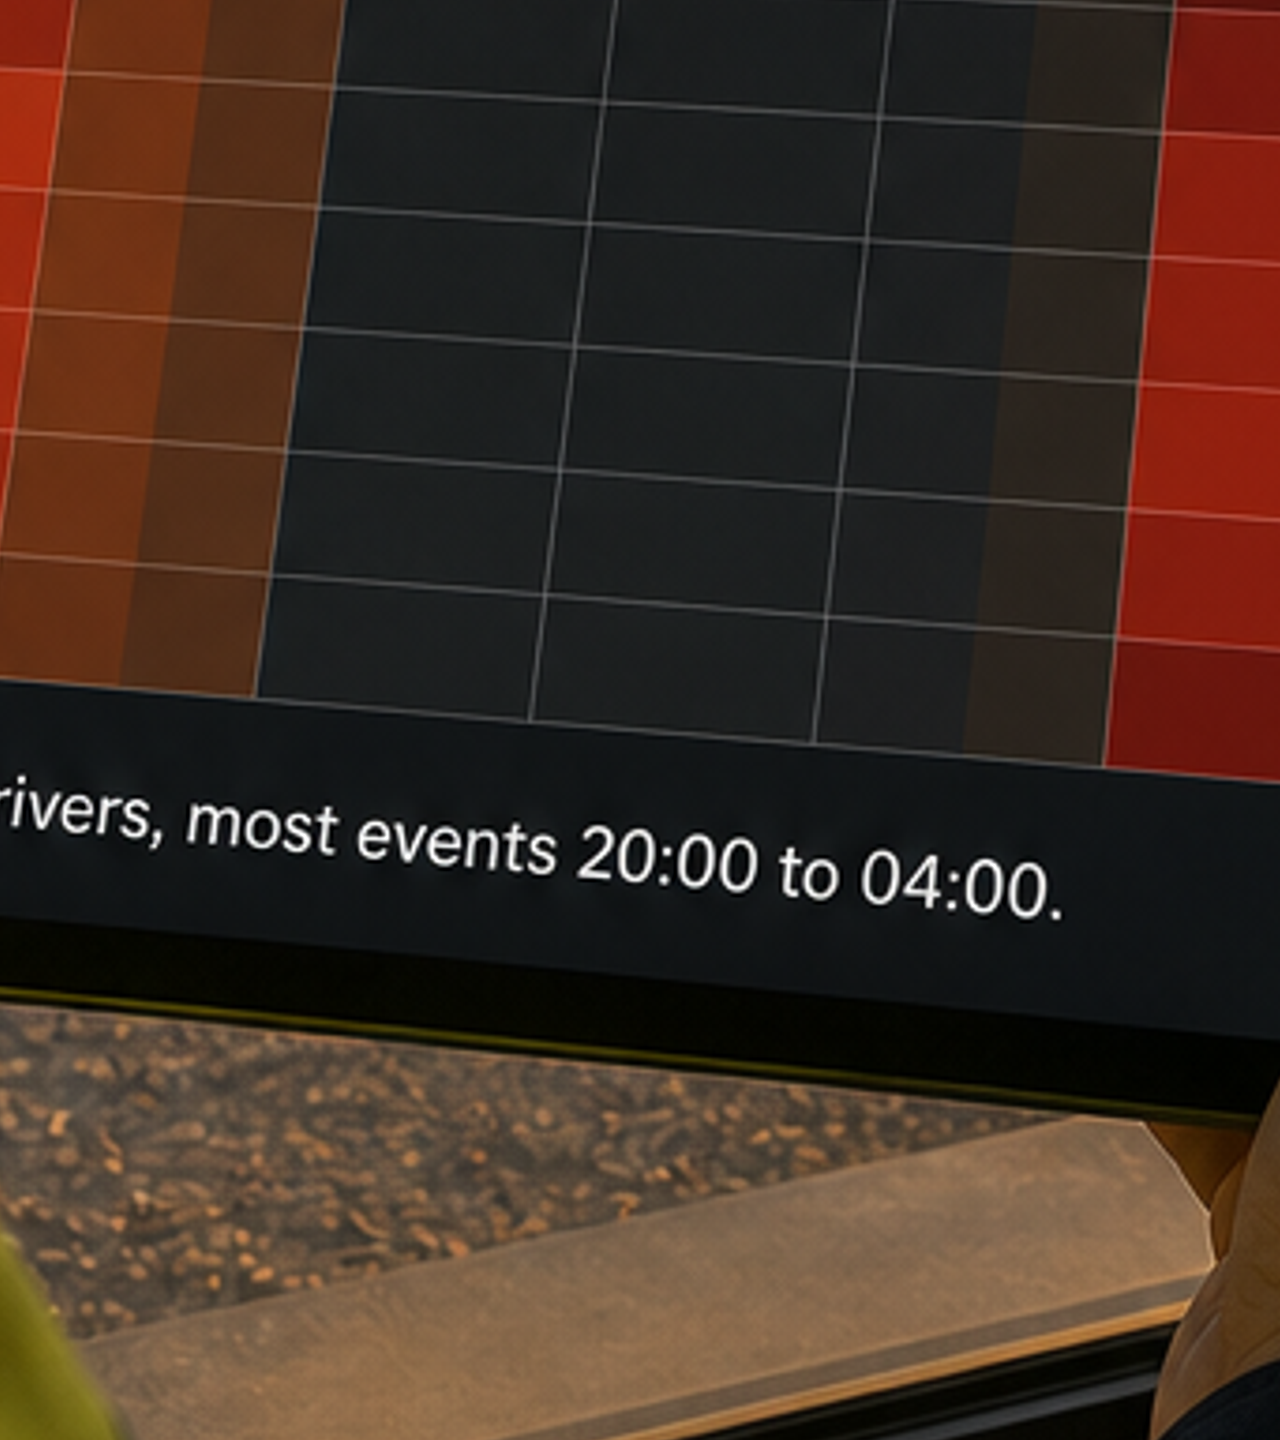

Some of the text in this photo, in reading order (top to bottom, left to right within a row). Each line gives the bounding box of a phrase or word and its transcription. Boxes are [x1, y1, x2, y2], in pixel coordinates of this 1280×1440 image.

[186, 803, 340, 856] most
[357, 819, 557, 876] events
[577, 824, 758, 894] 20:00
[778, 846, 840, 901] to
[861, 849, 1062, 921] 04:00.
